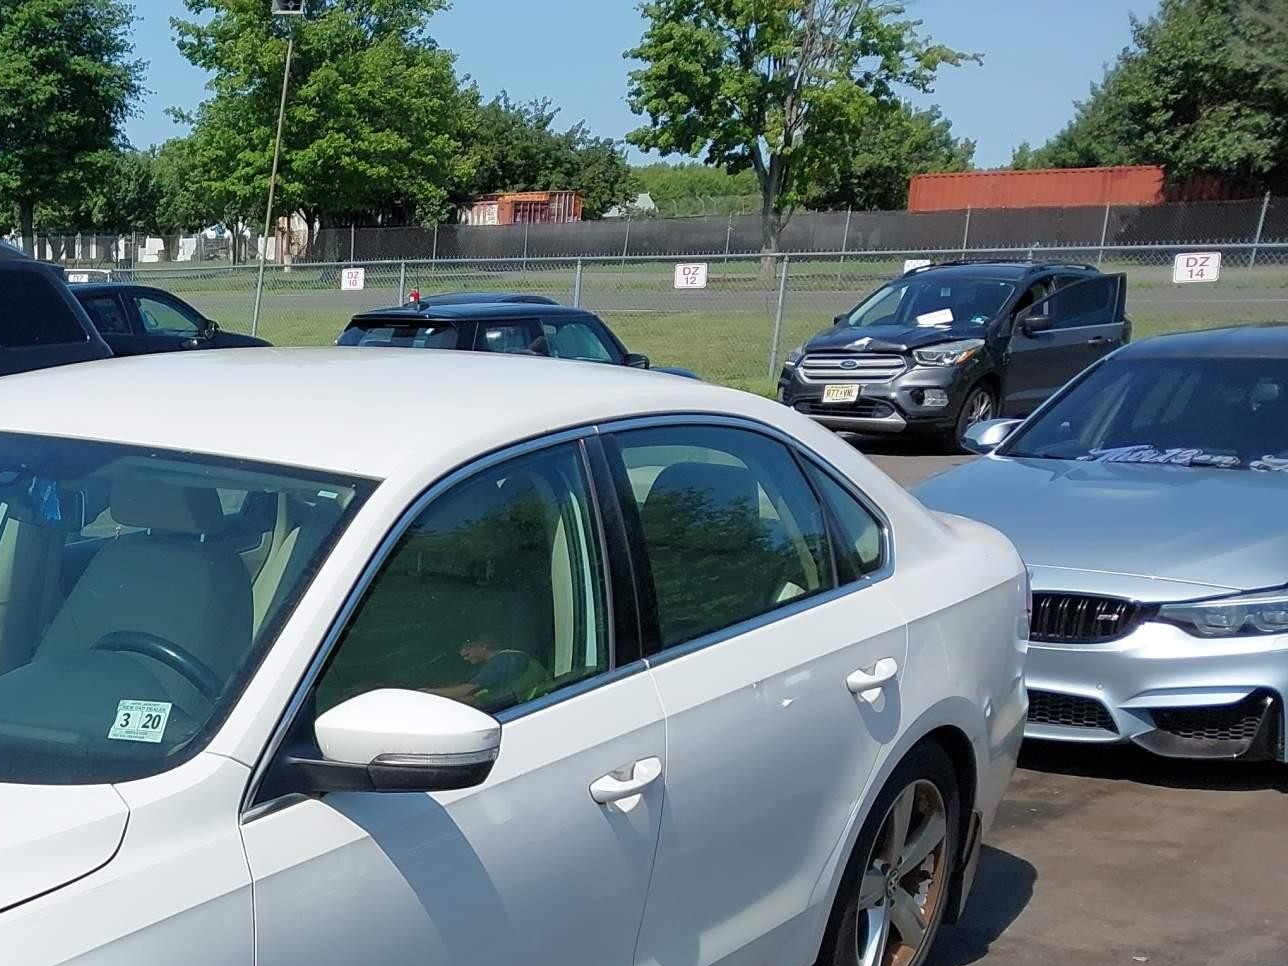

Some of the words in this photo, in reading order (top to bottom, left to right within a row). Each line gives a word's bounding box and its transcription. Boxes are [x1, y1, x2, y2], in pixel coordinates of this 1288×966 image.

[1186, 256, 1211, 267] DZ
[347, 271, 360, 279] DZ
[683, 267, 699, 275] DZ
[1188, 268, 1205, 278] 14
[349, 279, 358, 287] 10
[684, 276, 697, 285] 12
[120, 712, 131, 728] 3
[141, 713, 162, 730] 20
